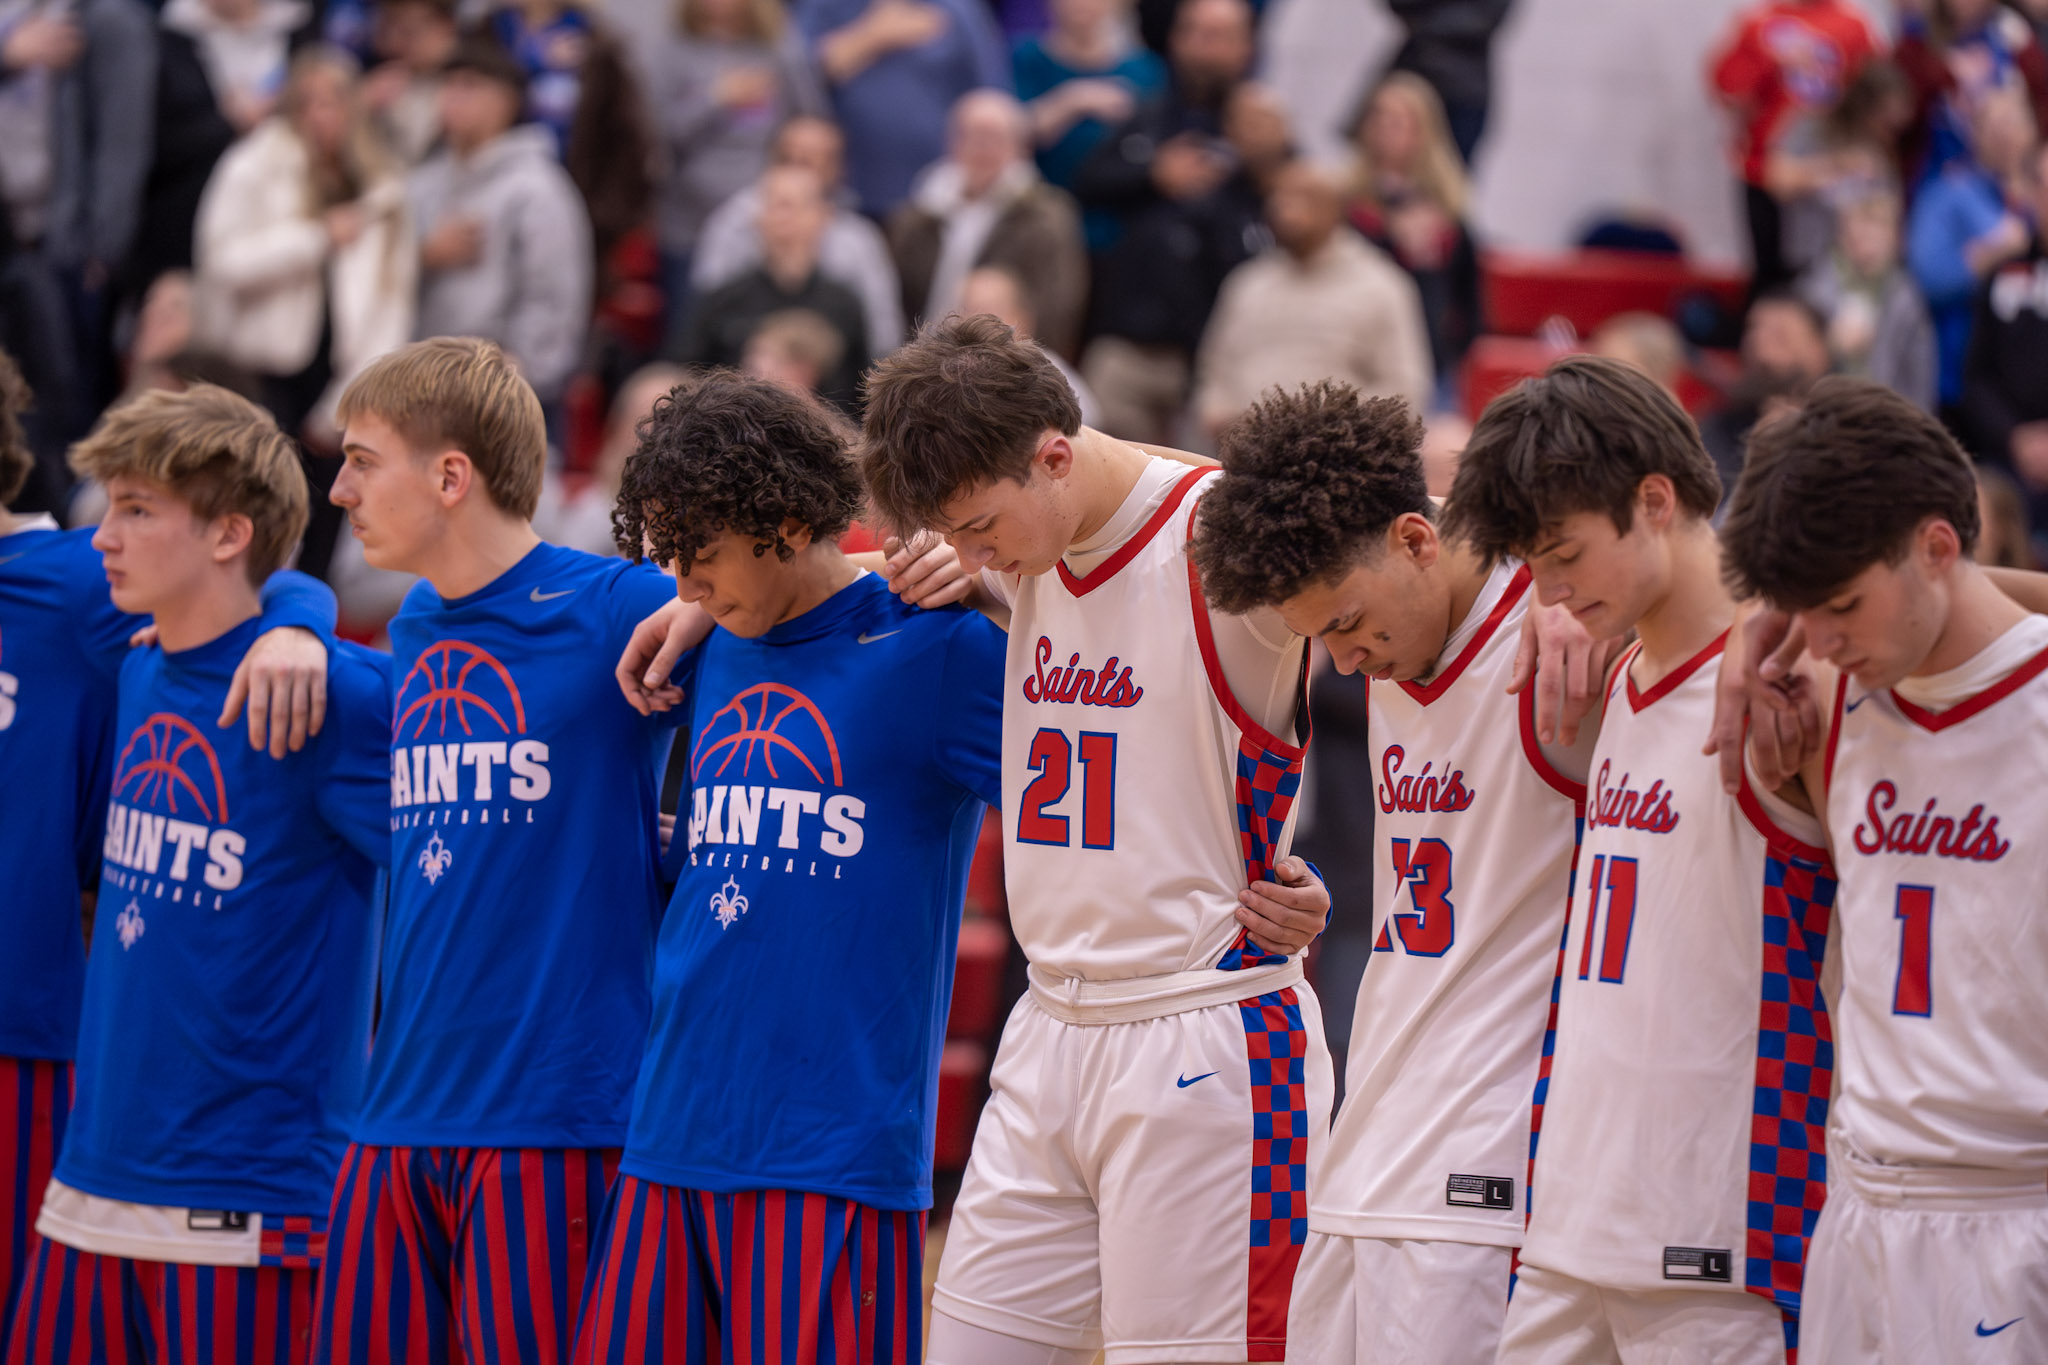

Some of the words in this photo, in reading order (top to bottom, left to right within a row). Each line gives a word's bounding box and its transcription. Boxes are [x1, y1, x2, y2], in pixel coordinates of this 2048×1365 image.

[1023, 636, 1143, 708] Saints
[388, 739, 551, 808] AINTS
[1017, 727, 1118, 851] 21
[1589, 758, 1680, 834] Saints
[103, 800, 247, 891] AINTS
[688, 784, 866, 858] AINTS
[1853, 779, 2010, 862] Saints
[691, 852, 842, 879] SKETBALL
[1373, 837, 1455, 959] 13
[1578, 854, 1638, 985] 11
[1892, 883, 1935, 1018] 1
[1493, 1186, 1503, 1200] L
[1709, 1258, 1721, 1272] L
